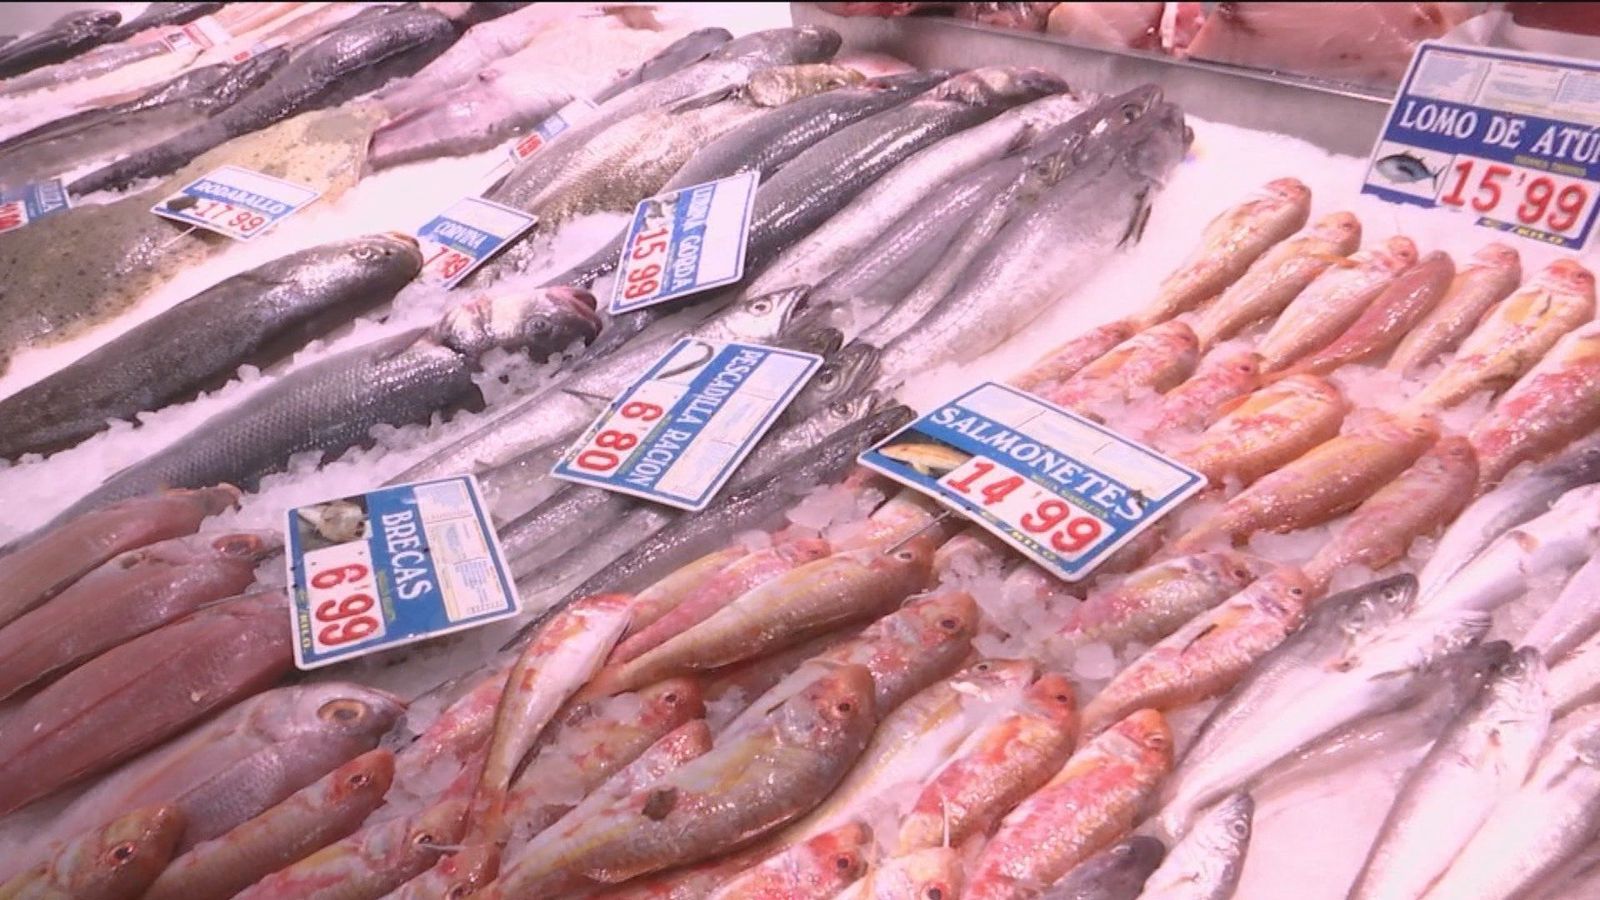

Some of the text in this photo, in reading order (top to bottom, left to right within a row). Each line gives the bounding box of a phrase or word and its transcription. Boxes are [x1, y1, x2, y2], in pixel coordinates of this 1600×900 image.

[1399, 100, 1479, 139] LOMO
[1482, 116, 1526, 150] DE
[677, 348, 764, 425] PESCADILLA
[626, 427, 696, 487] RACION
[930, 403, 1149, 522] SALMONETES
[381, 509, 433, 601] BRECAS
